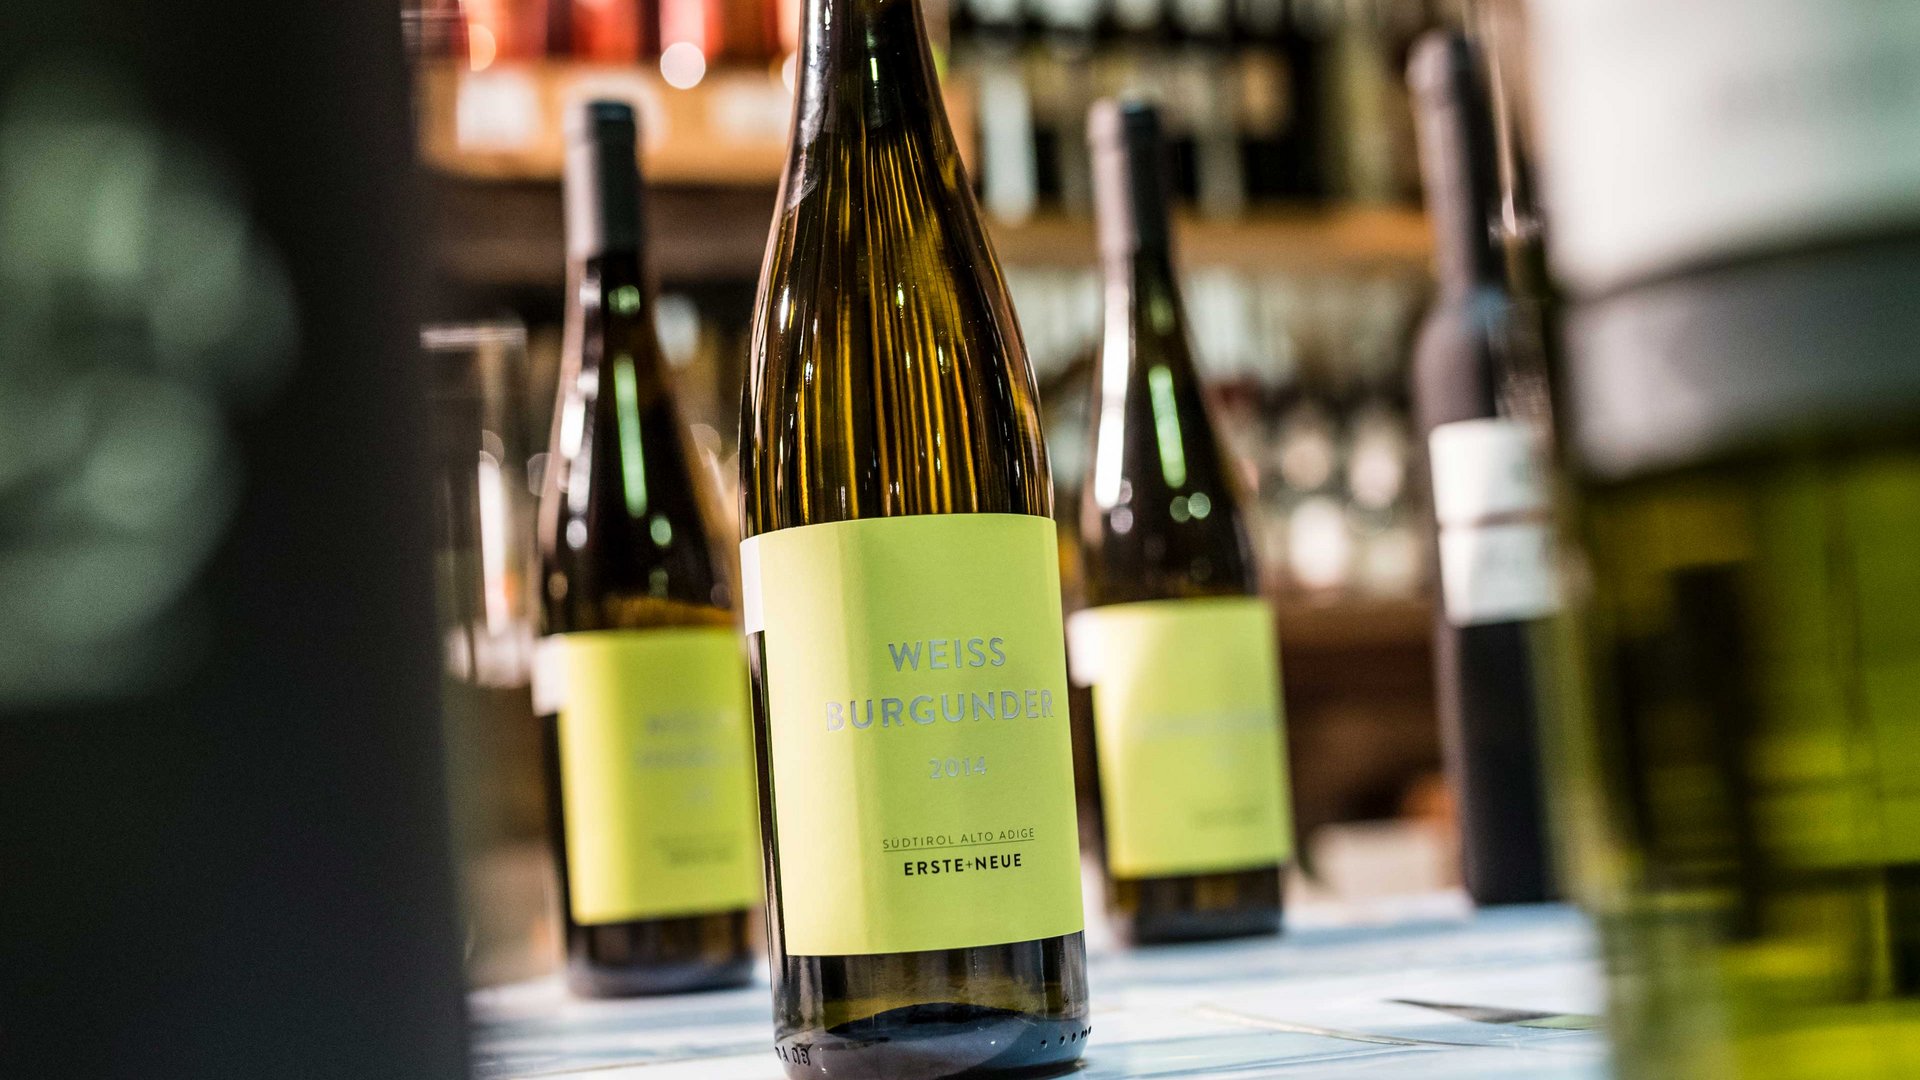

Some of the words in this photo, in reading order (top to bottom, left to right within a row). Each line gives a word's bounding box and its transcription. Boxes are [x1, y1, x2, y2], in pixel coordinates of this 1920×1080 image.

[888, 637, 1006, 672] WEISS
[826, 690, 1055, 732] BURGUNDER
[929, 757, 987, 778] 2014
[882, 834, 955, 850] SÜDTIROL
[961, 831, 994, 844] ALTO
[999, 827, 1035, 841] ADIGE
[904, 853, 1022, 876] ERSTE+NEUE
